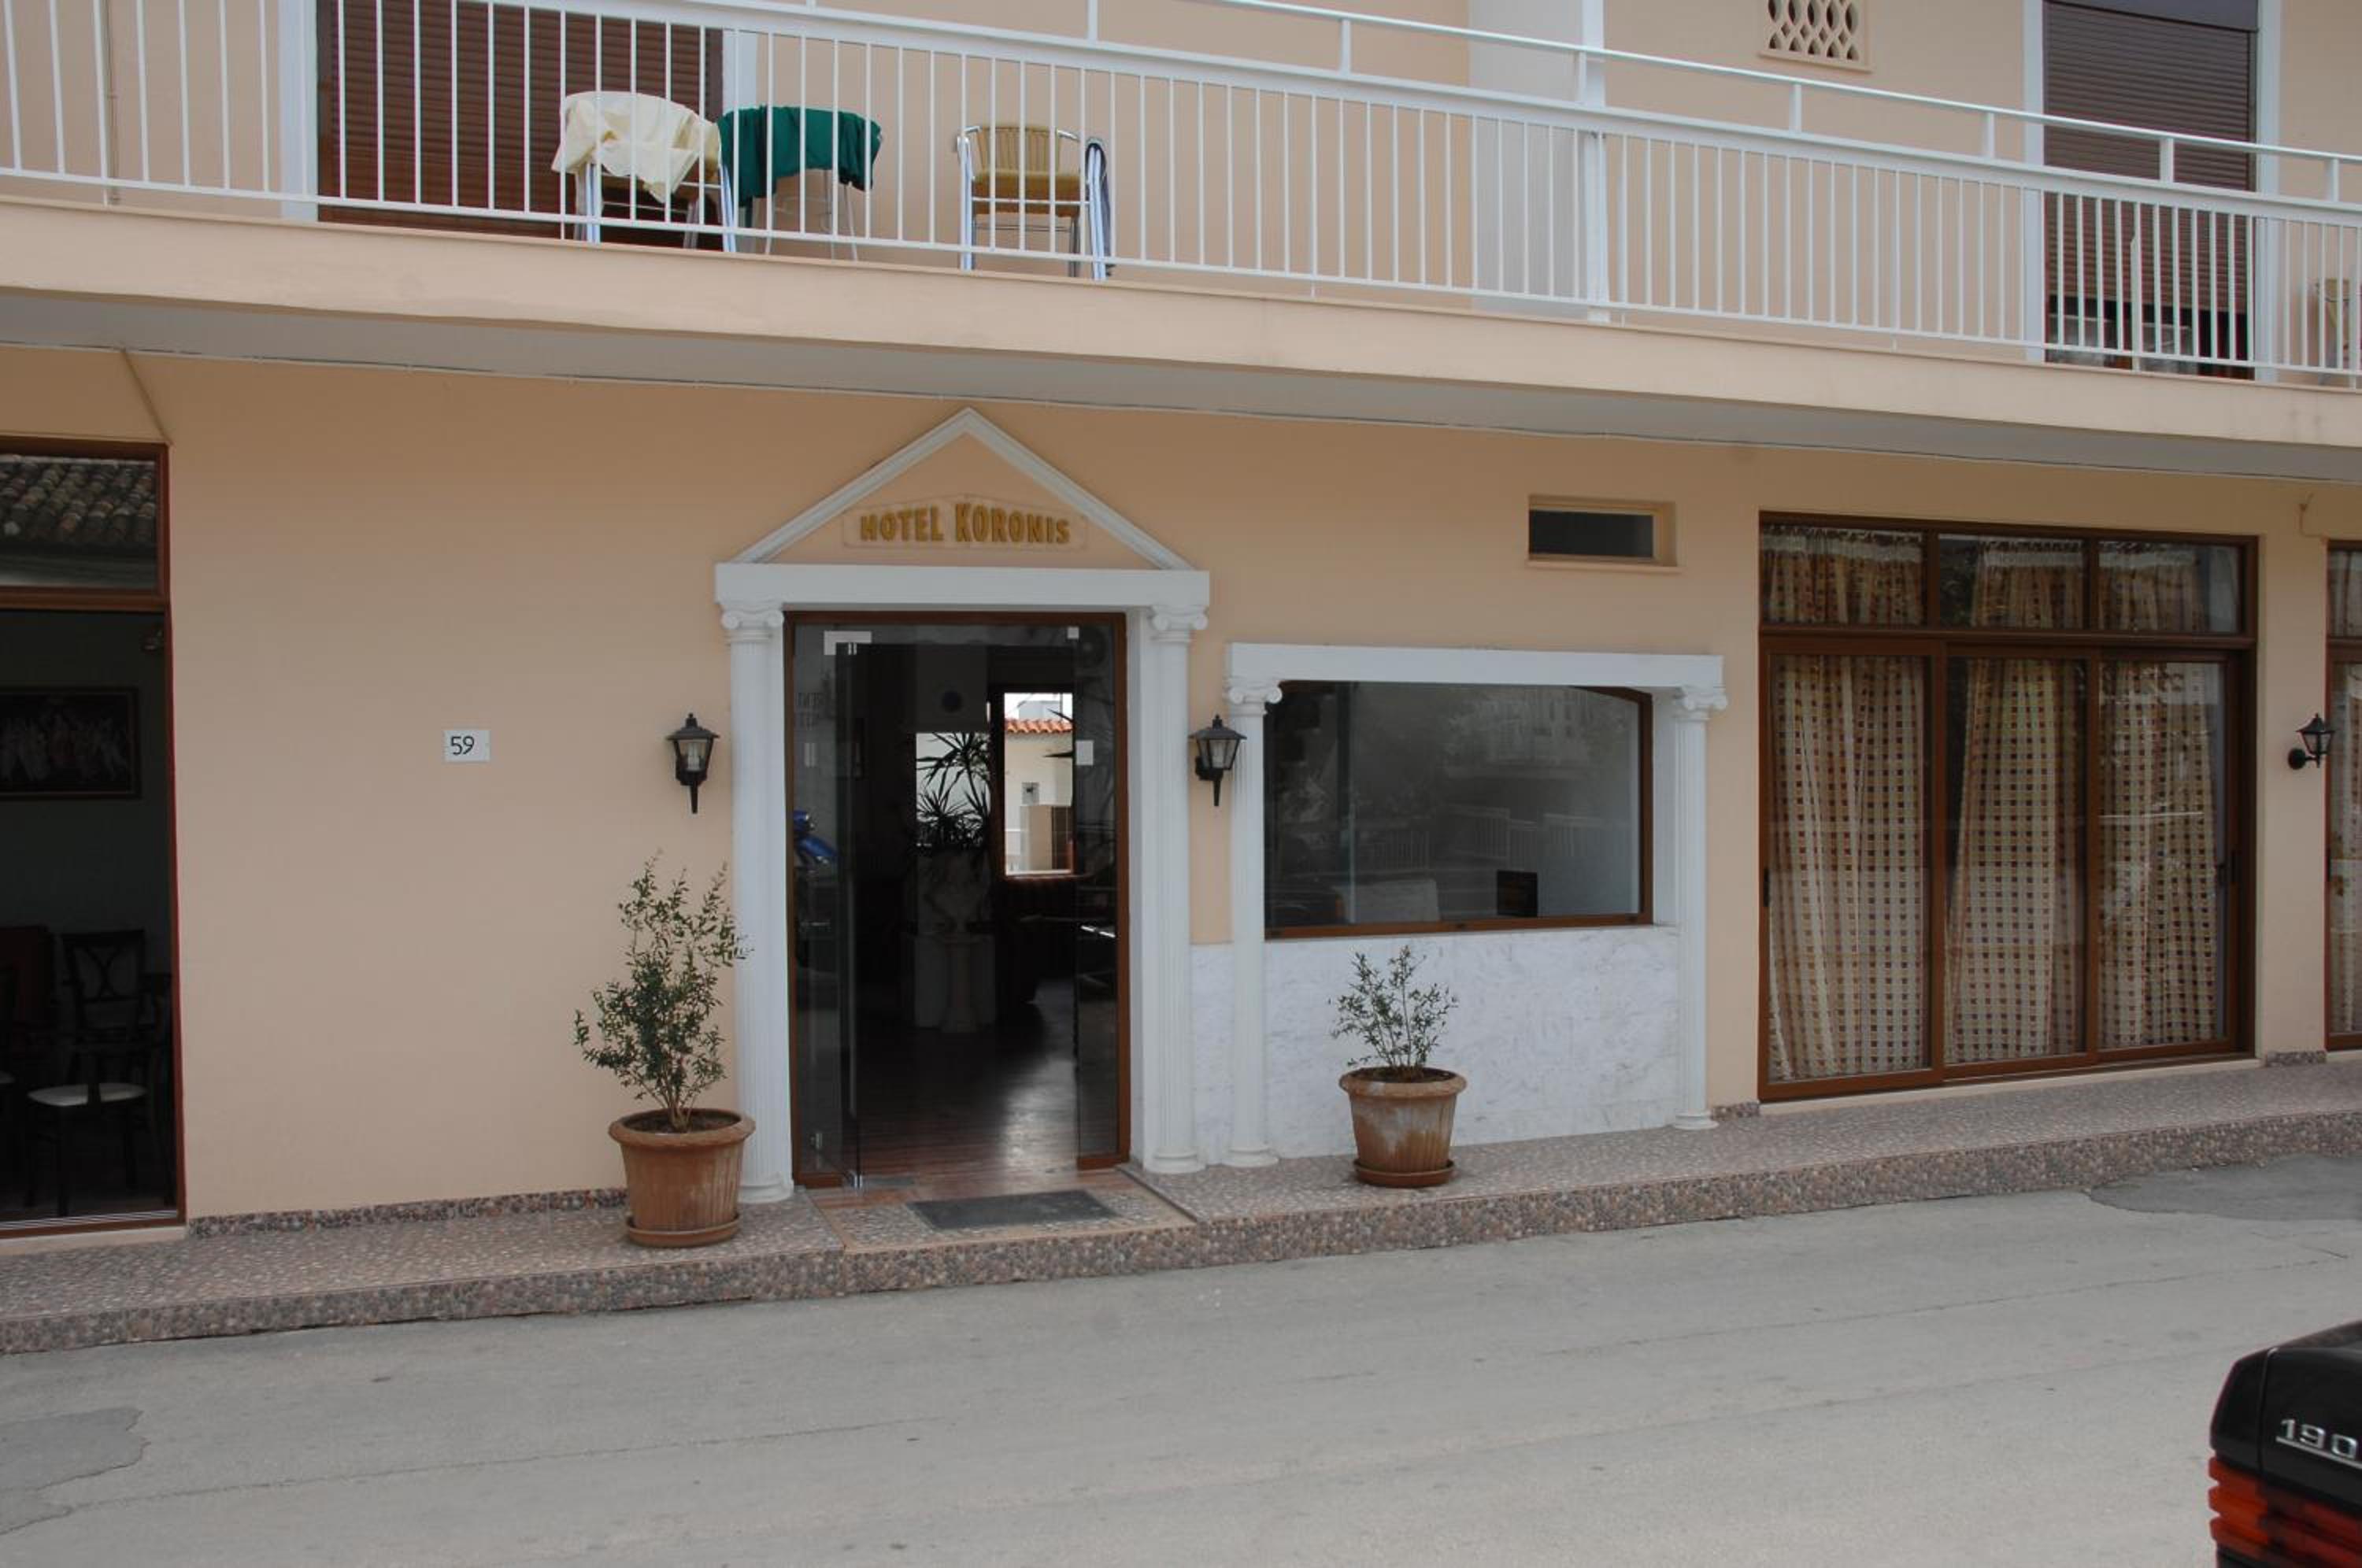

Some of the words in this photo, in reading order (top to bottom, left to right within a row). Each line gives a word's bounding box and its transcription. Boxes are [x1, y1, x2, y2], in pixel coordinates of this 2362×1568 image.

[860, 505, 945, 542] HOTEL
[954, 502, 1071, 543] KORONIS
[450, 735, 475, 756] 59
[2280, 1418, 2358, 1460] 190
